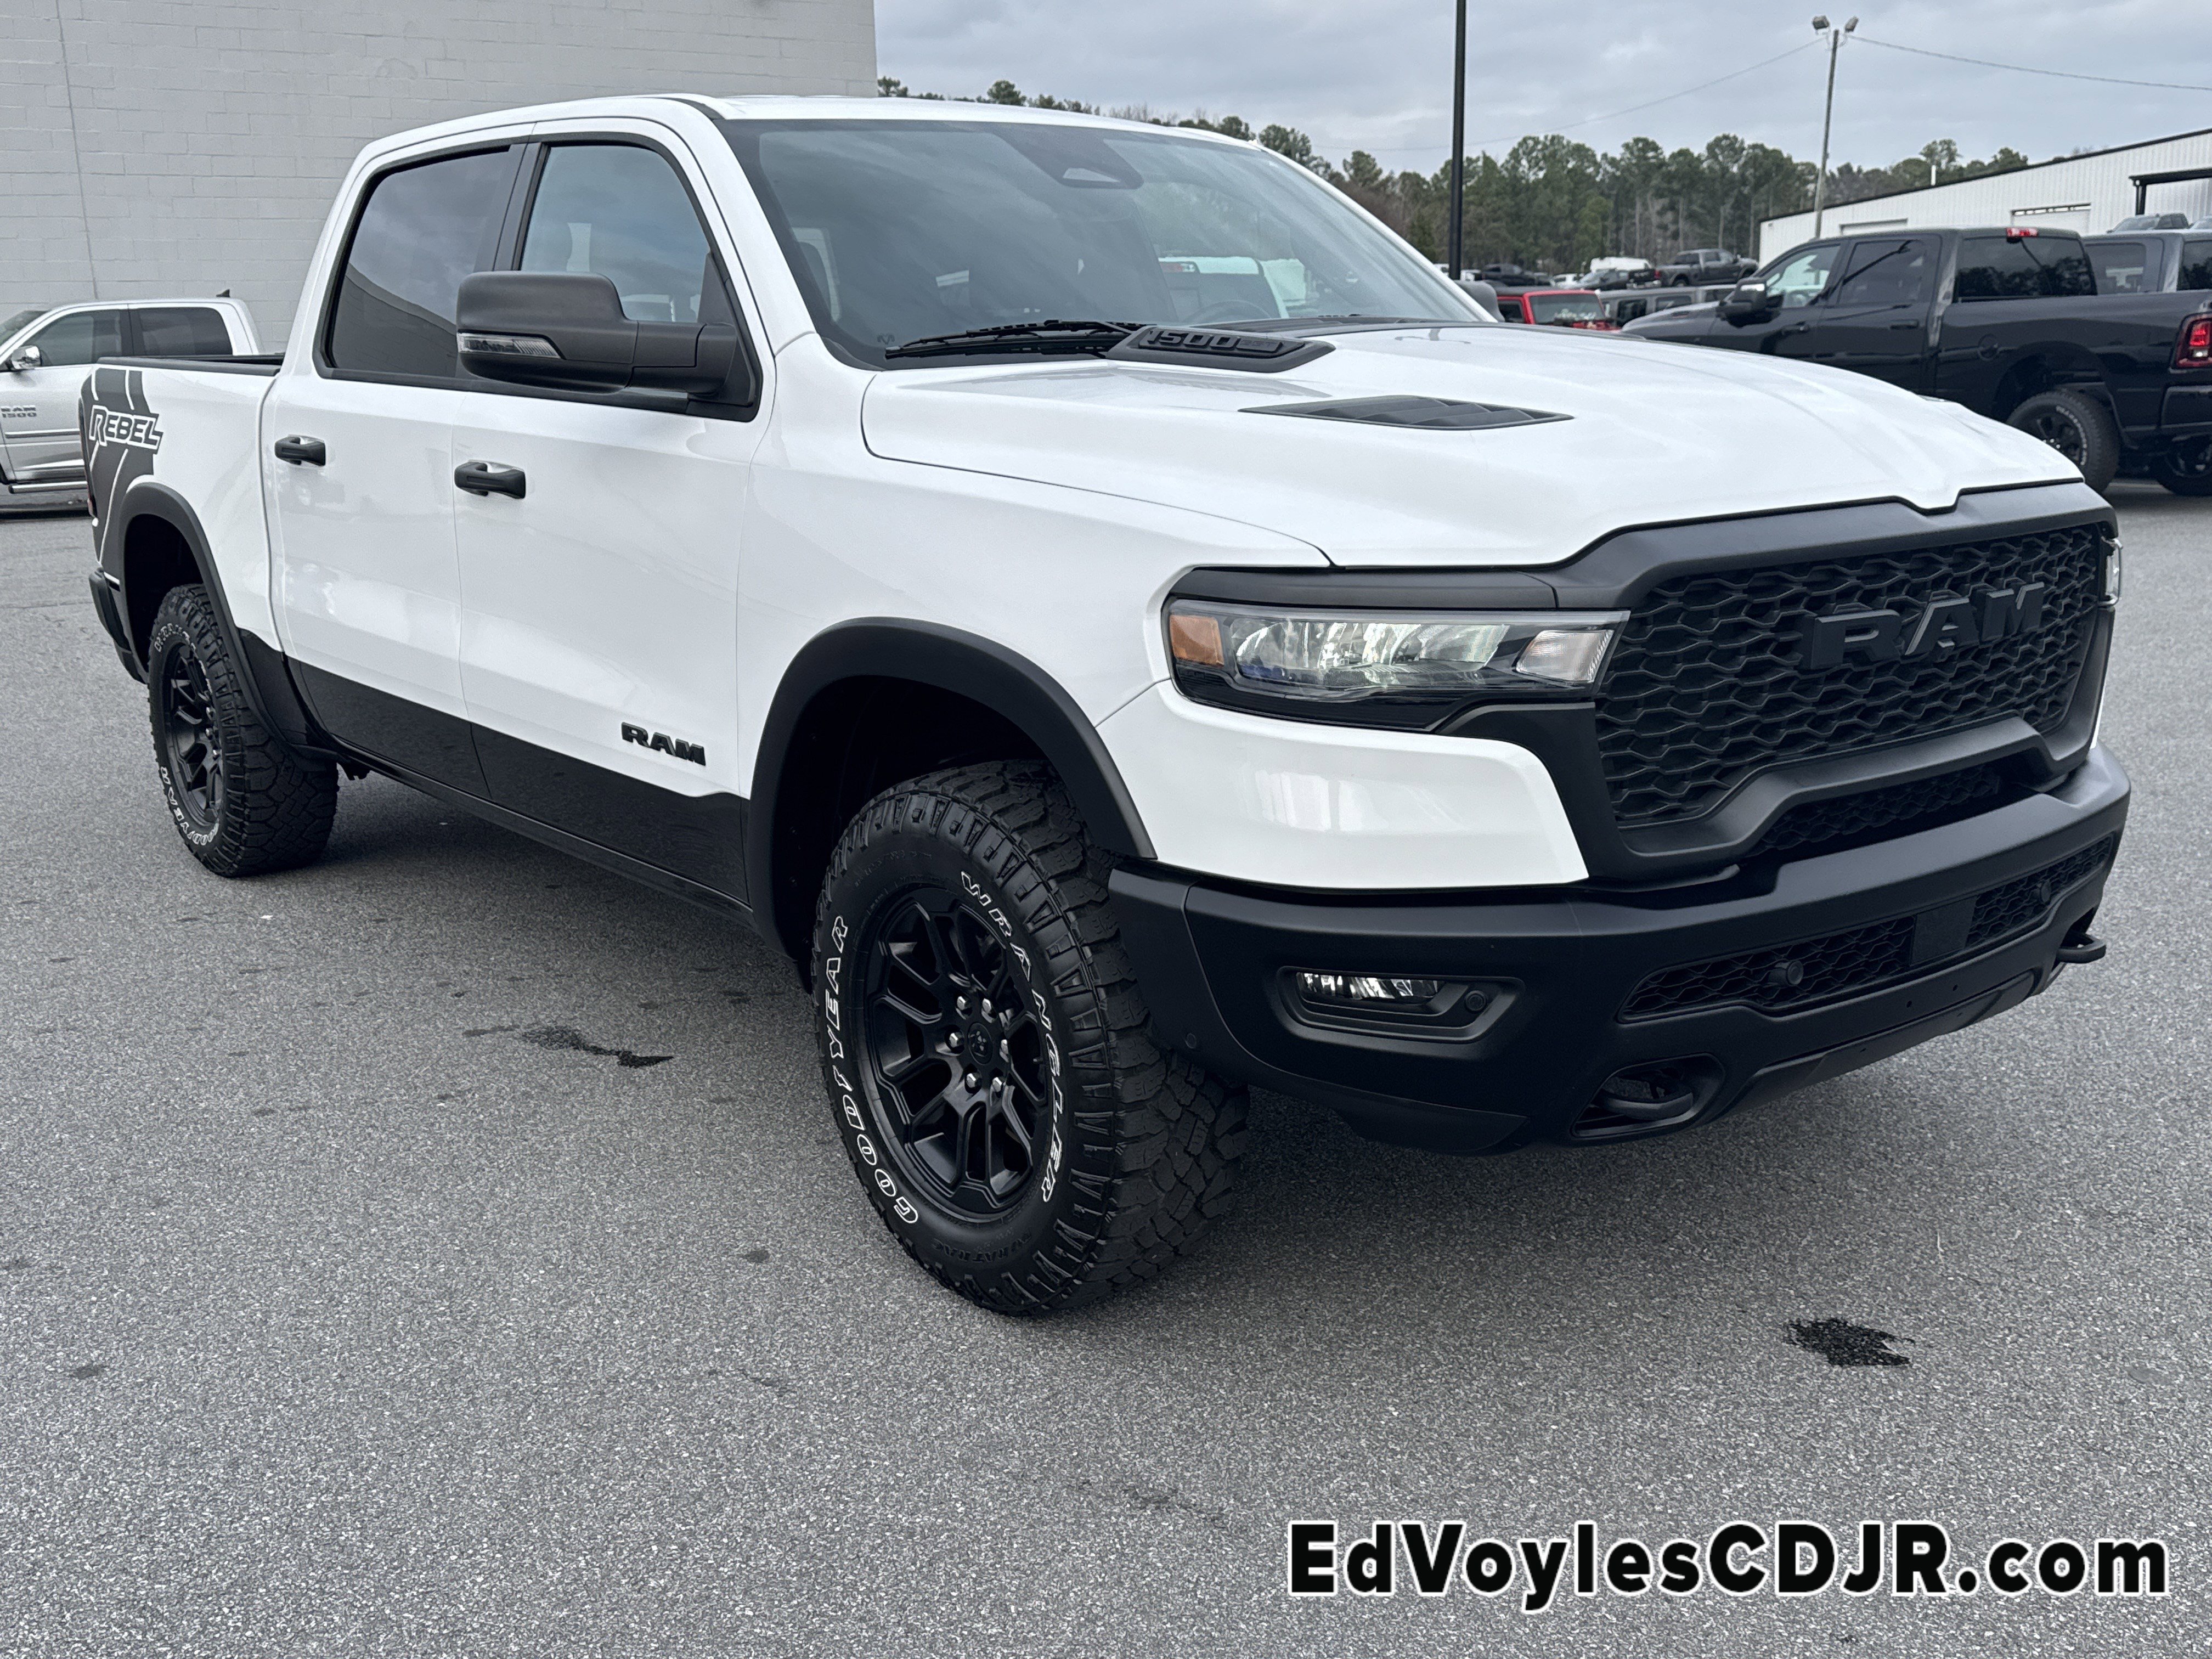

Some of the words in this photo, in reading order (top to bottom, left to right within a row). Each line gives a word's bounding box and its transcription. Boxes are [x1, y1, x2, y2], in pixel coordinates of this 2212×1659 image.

[1147, 329, 1239, 350] 1500
[89, 405, 161, 450] REBEL
[1810, 582, 2045, 668] RAM
[621, 721, 706, 766] RAM
[961, 871, 1064, 1202] WRANGLER
[825, 915, 918, 1224] GOODYEAR
